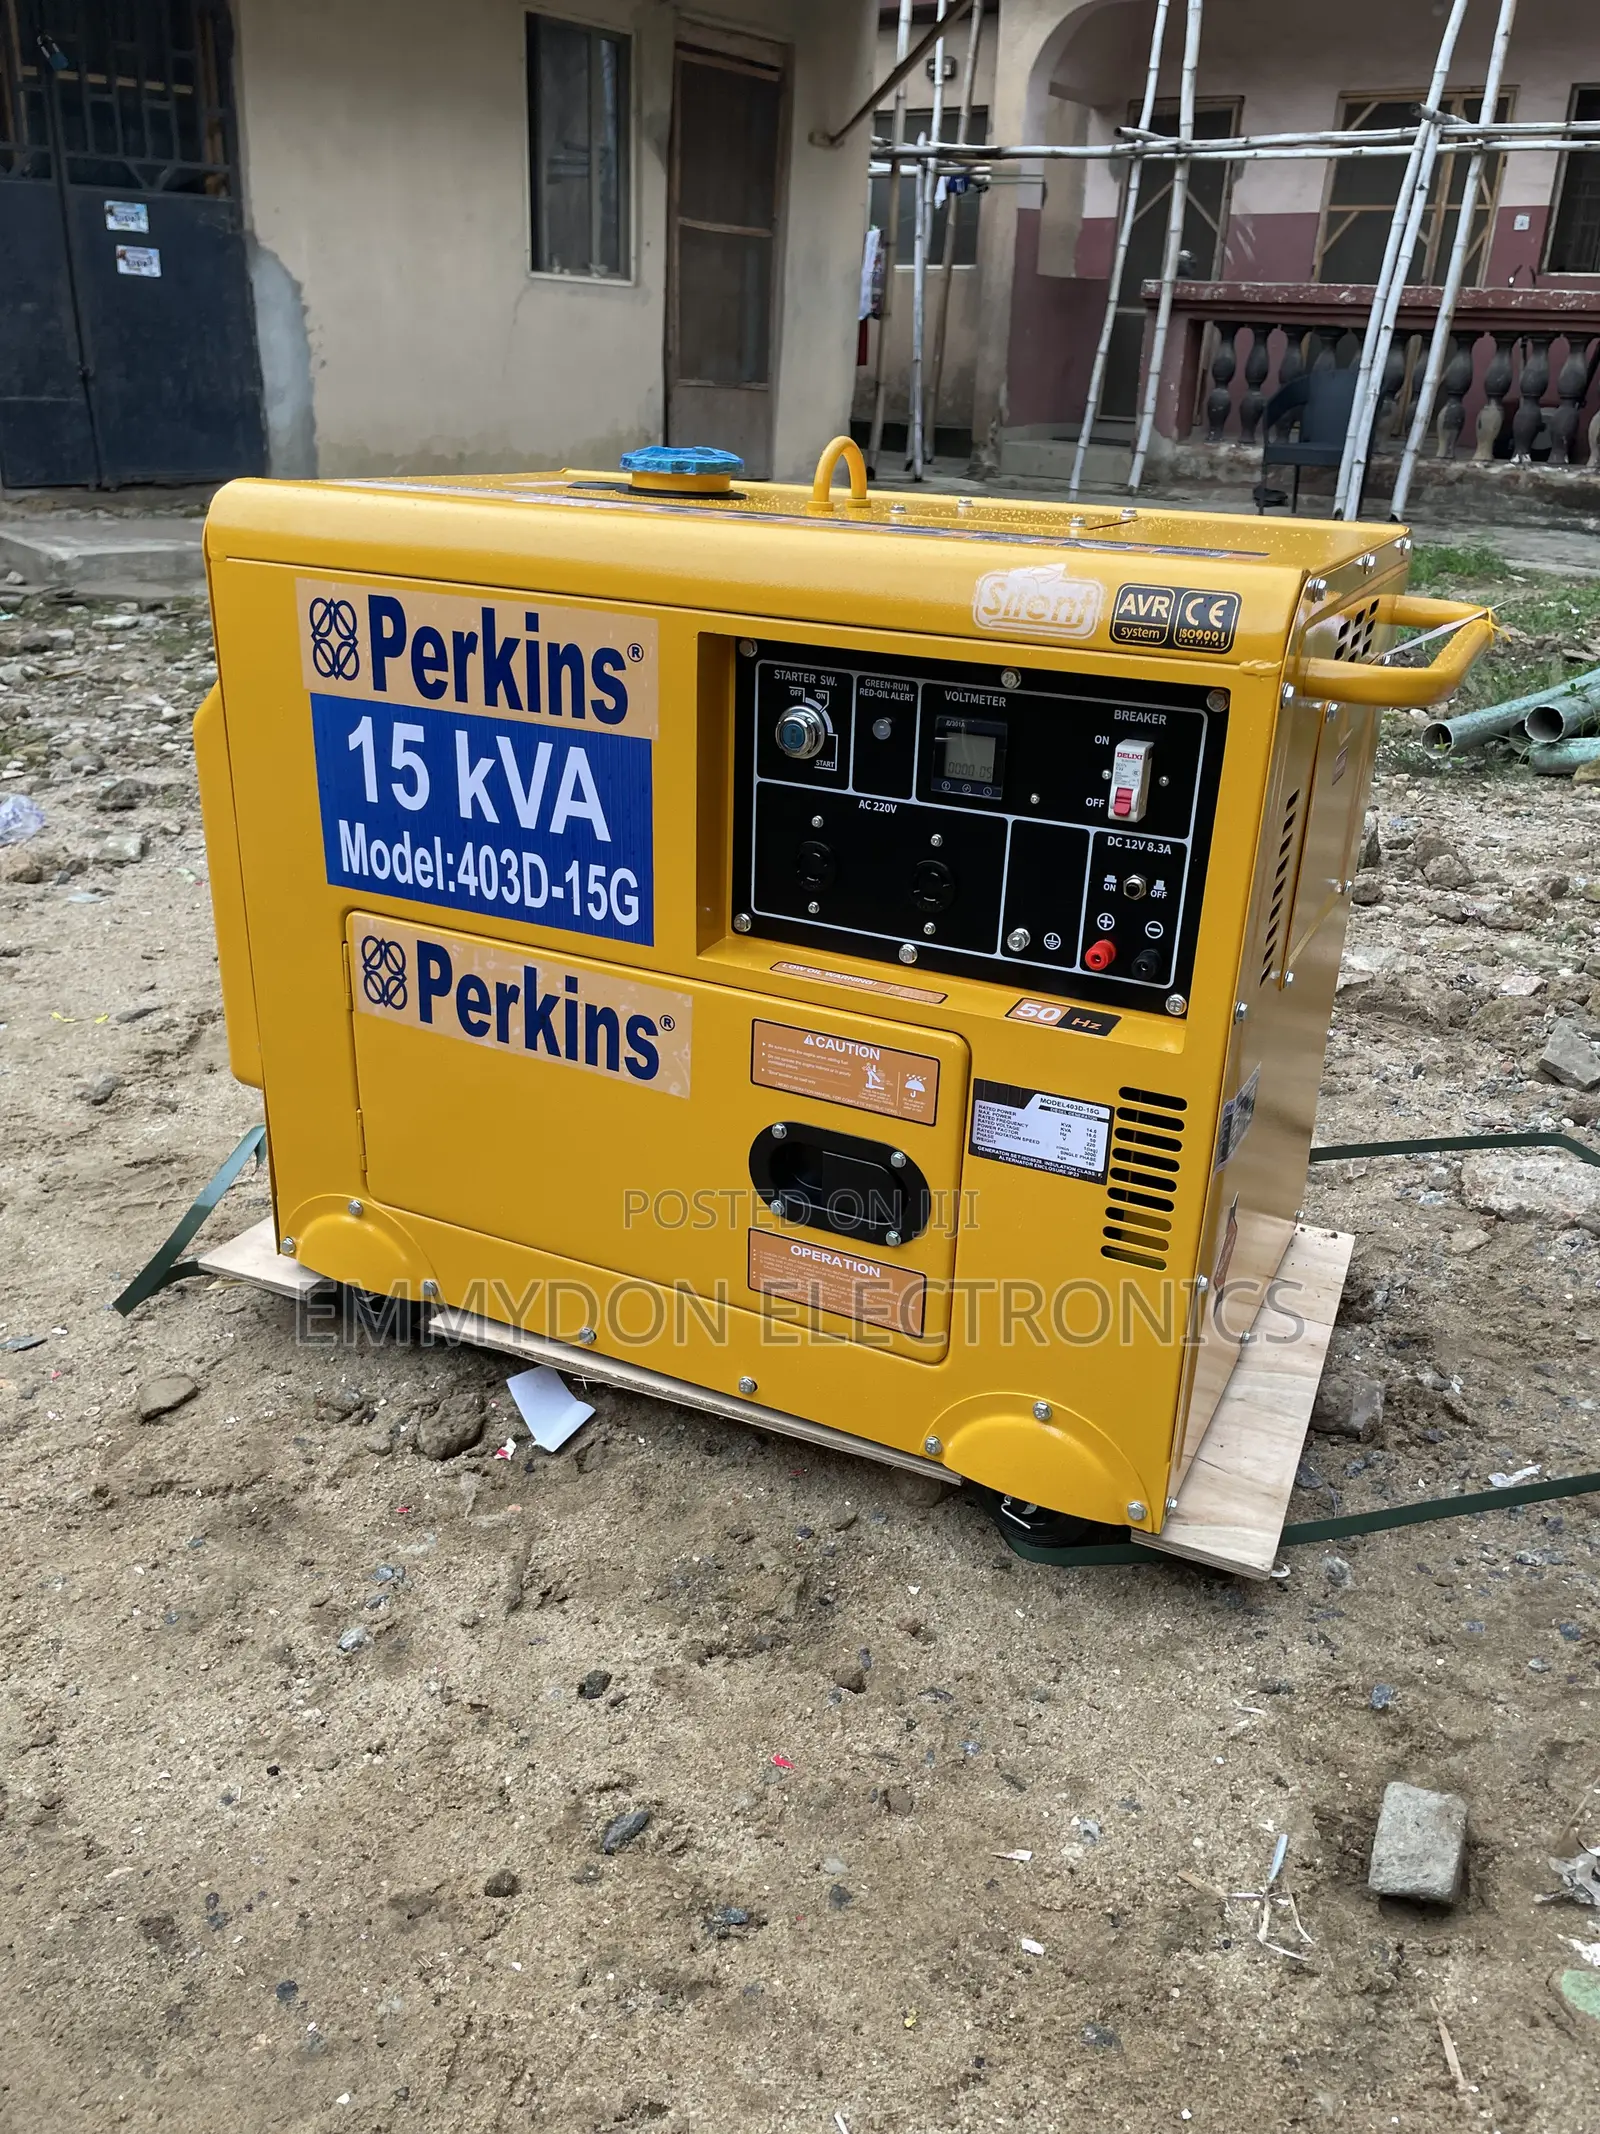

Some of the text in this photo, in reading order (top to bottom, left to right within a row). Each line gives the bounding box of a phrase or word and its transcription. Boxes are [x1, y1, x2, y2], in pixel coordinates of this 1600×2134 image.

[1119, 593, 1169, 618] AVR
[1185, 598, 1227, 628] CE
[1120, 626, 1159, 640] system
[1179, 628, 1226, 642] ISO9001
[774, 670, 838, 686] STARTER SW.
[865, 678, 909, 692] GREEN-RUN
[816, 692, 826, 700] ON
[860, 688, 914, 702] RED-OIL ALERT
[945, 690, 1006, 707] VOLTMETER
[1114, 710, 1166, 725] BREAKER
[1095, 735, 1109, 745] ON
[1117, 752, 1143, 760] DELIXI
[816, 760, 834, 768] START
[348, 716, 611, 842] 15 kVA
[859, 800, 897, 814] AC 220V
[1086, 798, 1105, 807] OFF
[1107, 836, 1172, 854] DC 12V 8.3A
[338, 820, 638, 926] Model:403D-15G
[1104, 883, 1116, 892] ON
[1150, 890, 1167, 899] OFF
[782, 963, 806, 972] LOW
[1016, 1003, 1102, 1031] 50 Hz
[816, 1036, 880, 1060] CAUTION
[790, 1245, 880, 1278] OPERATION
